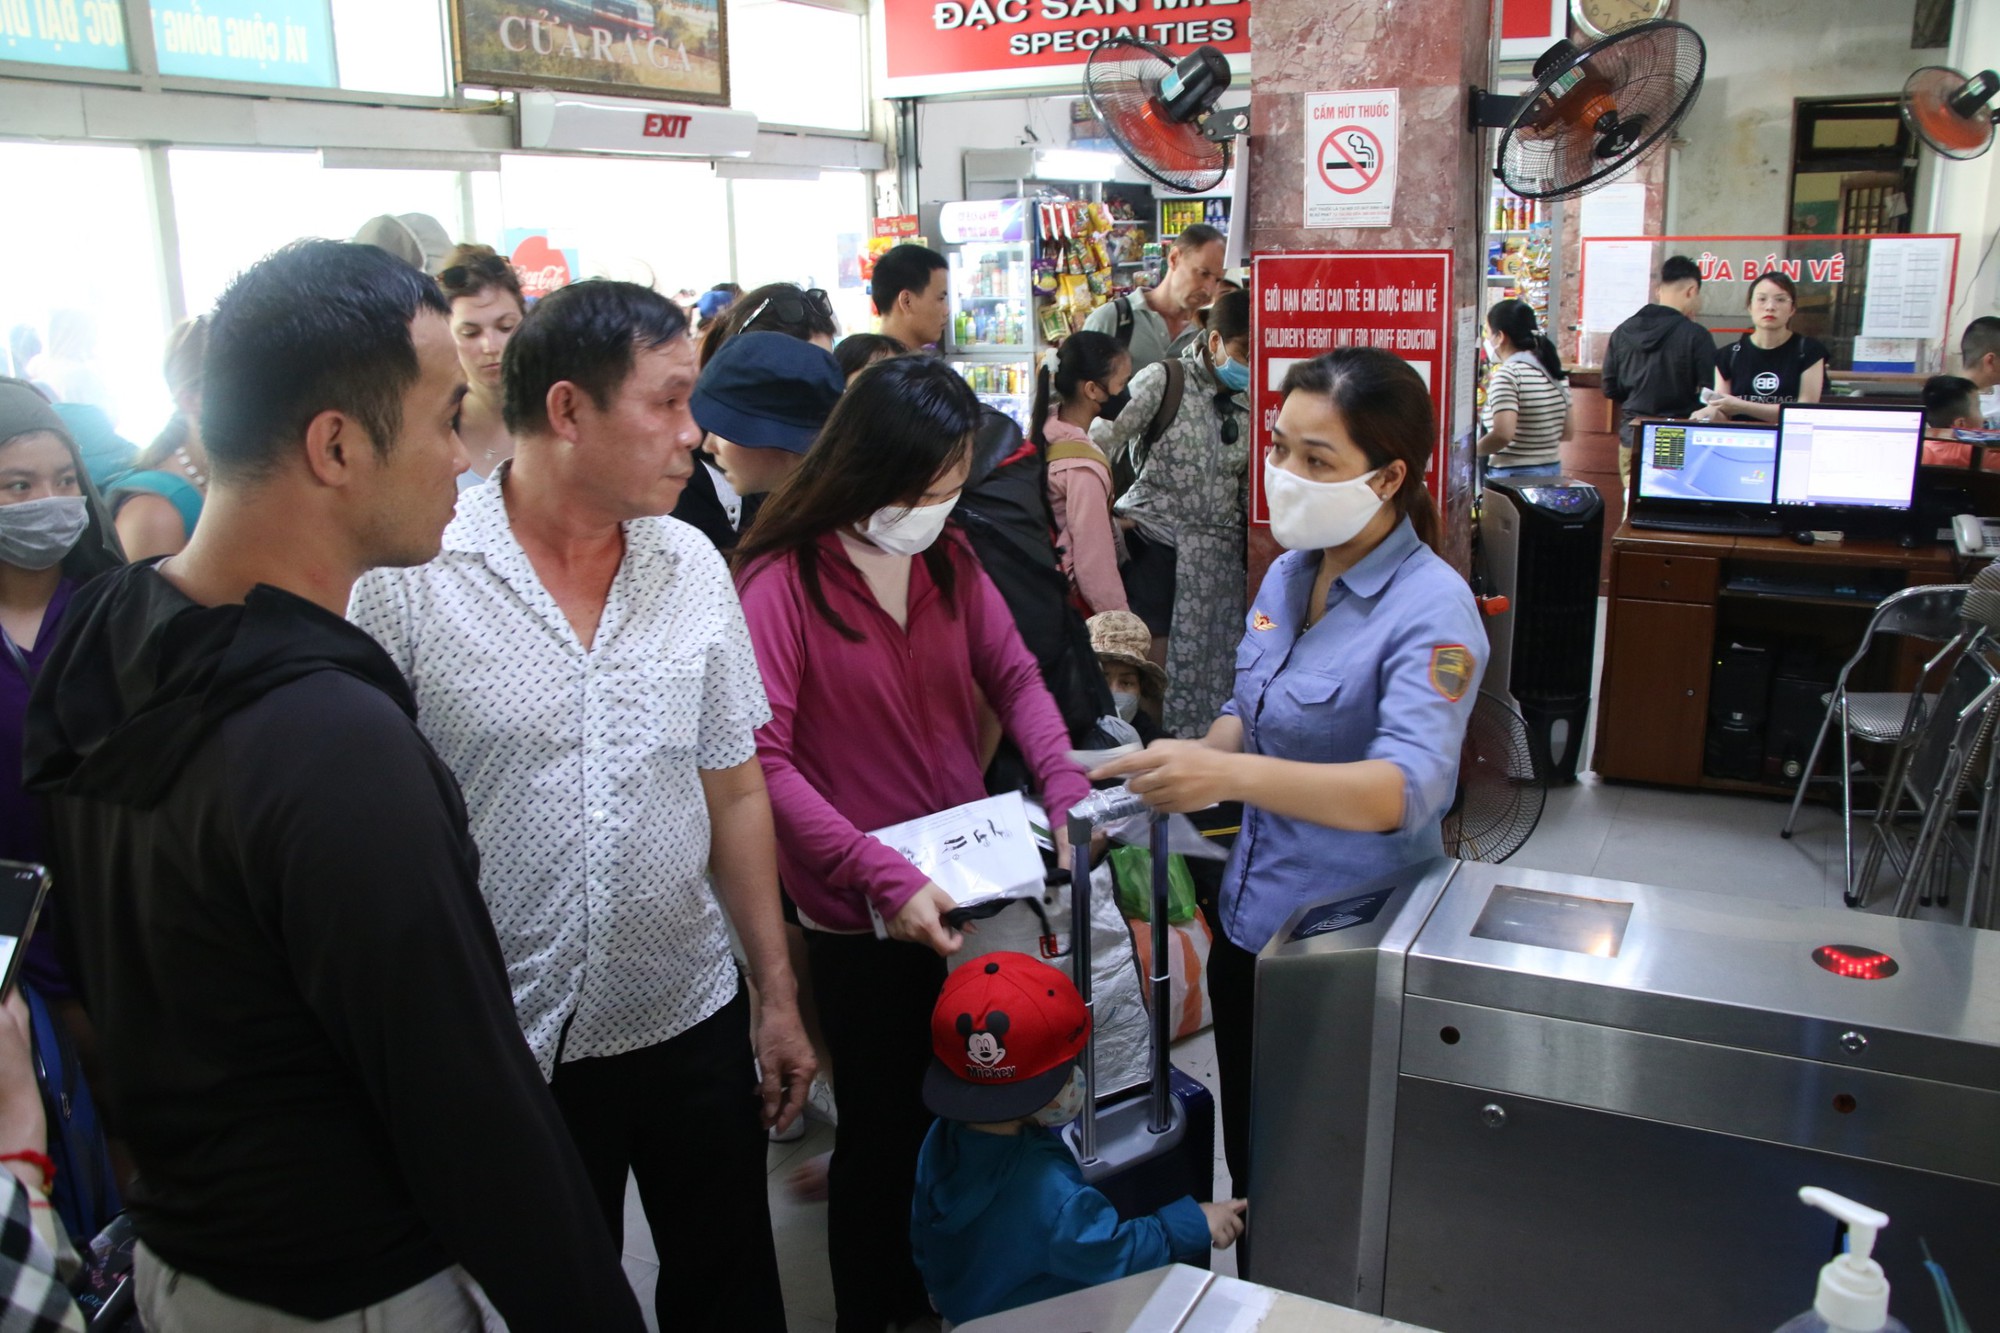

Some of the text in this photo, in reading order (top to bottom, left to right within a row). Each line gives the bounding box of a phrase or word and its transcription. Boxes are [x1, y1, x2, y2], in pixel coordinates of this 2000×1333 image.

[1010, 19, 1234, 56] SPECIALTIES
[1313, 99, 1389, 120] CẤM HÚT THUỐC
[643, 114, 692, 138] EXIT
[1698, 251, 1845, 282] ỬA BÁN VÉ
[1265, 277, 1437, 317] GIỚI HẠN CHIỀU CAO TRẺ EM ĐƯỢC GIẢM VÉ
[1265, 327, 1436, 350] CHILDREN'S HEIGHT LIMIT FOR TARIFF REDUCTION
